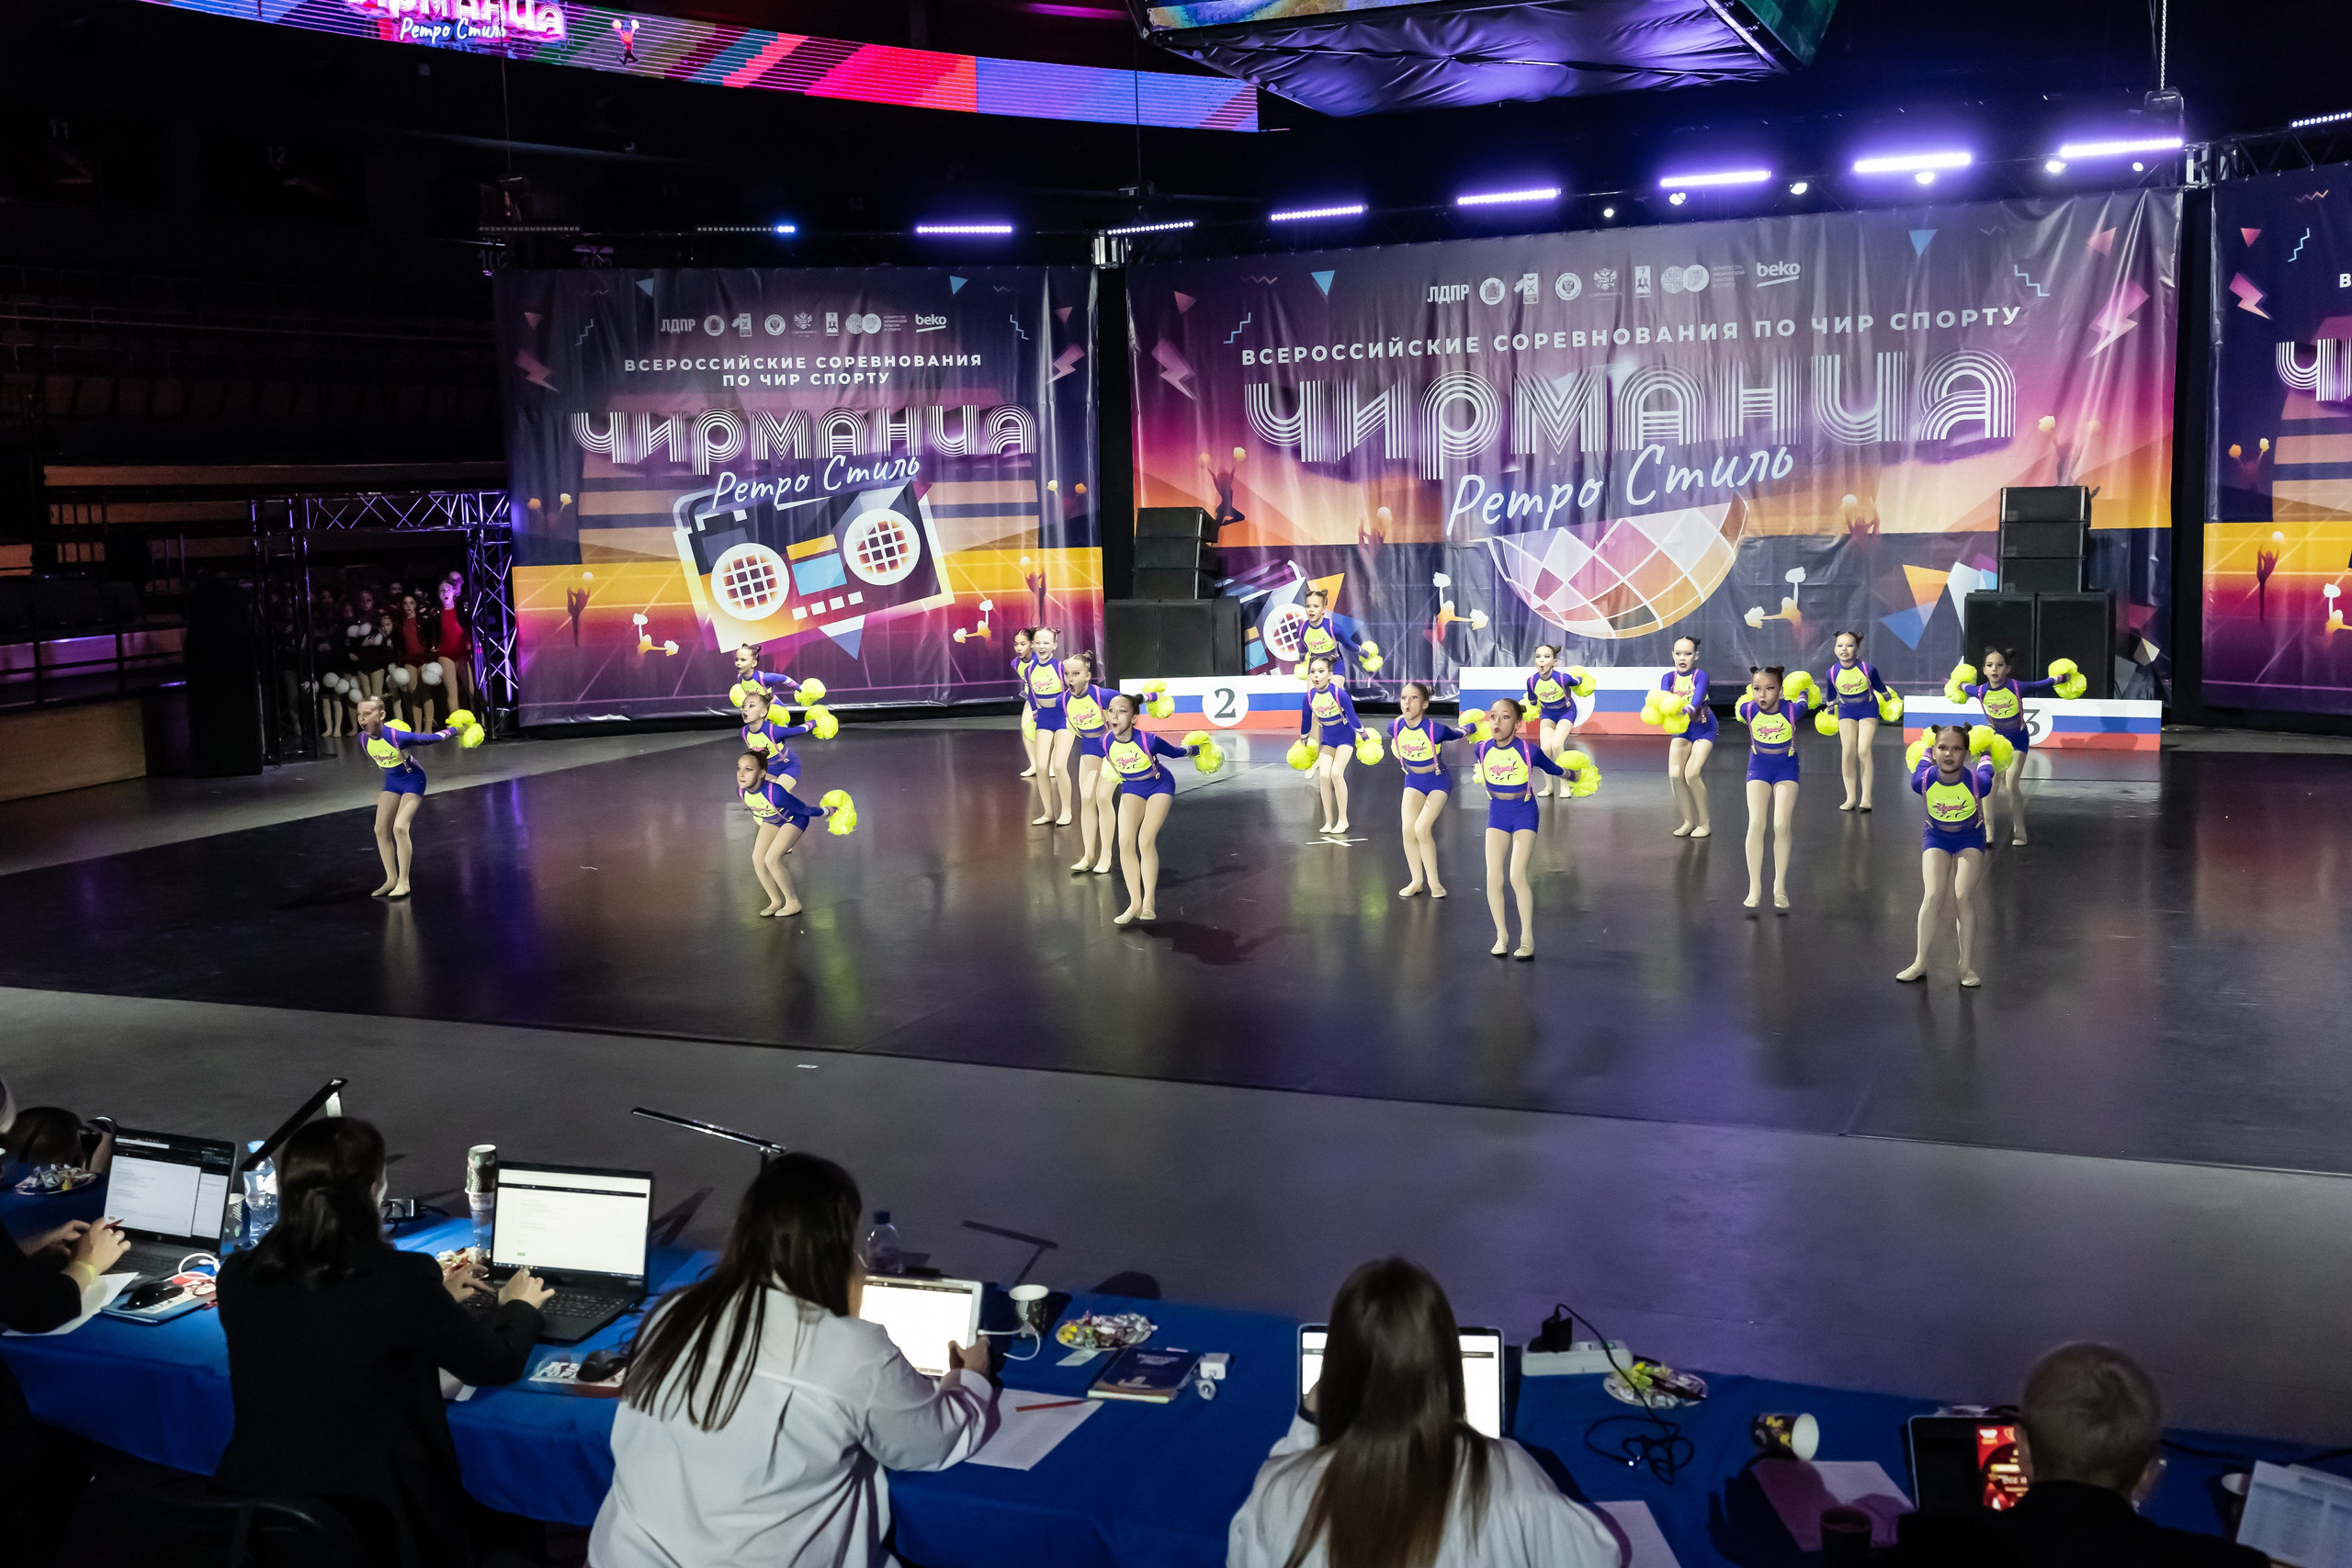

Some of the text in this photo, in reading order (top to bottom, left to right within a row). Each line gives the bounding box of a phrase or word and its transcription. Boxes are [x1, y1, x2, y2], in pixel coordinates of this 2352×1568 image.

[400, 17, 451, 44] Ретро
[1757, 261, 1802, 277] beko
[1427, 284, 1470, 305] ЛДПР
[660, 318, 696, 334] ЛДПР
[915, 313, 947, 326] beko
[1241, 306, 2021, 366] ВСЕРОССИЙСКИЕ СОРЕВНОВАНИЯ ПО ЧИР СПОРТУ
[624, 354, 982, 372] ВСЕРОССИЙСКИЕ СОРЕВНОВАНИЯ
[722, 372, 890, 387] ПО ЧИР СПОРТУ
[712, 453, 921, 510] Ретро Стиль
[1446, 444, 1794, 536] Ретро Стиль
[1214, 687, 1237, 718] 2
[2023, 708, 2041, 737] 3
